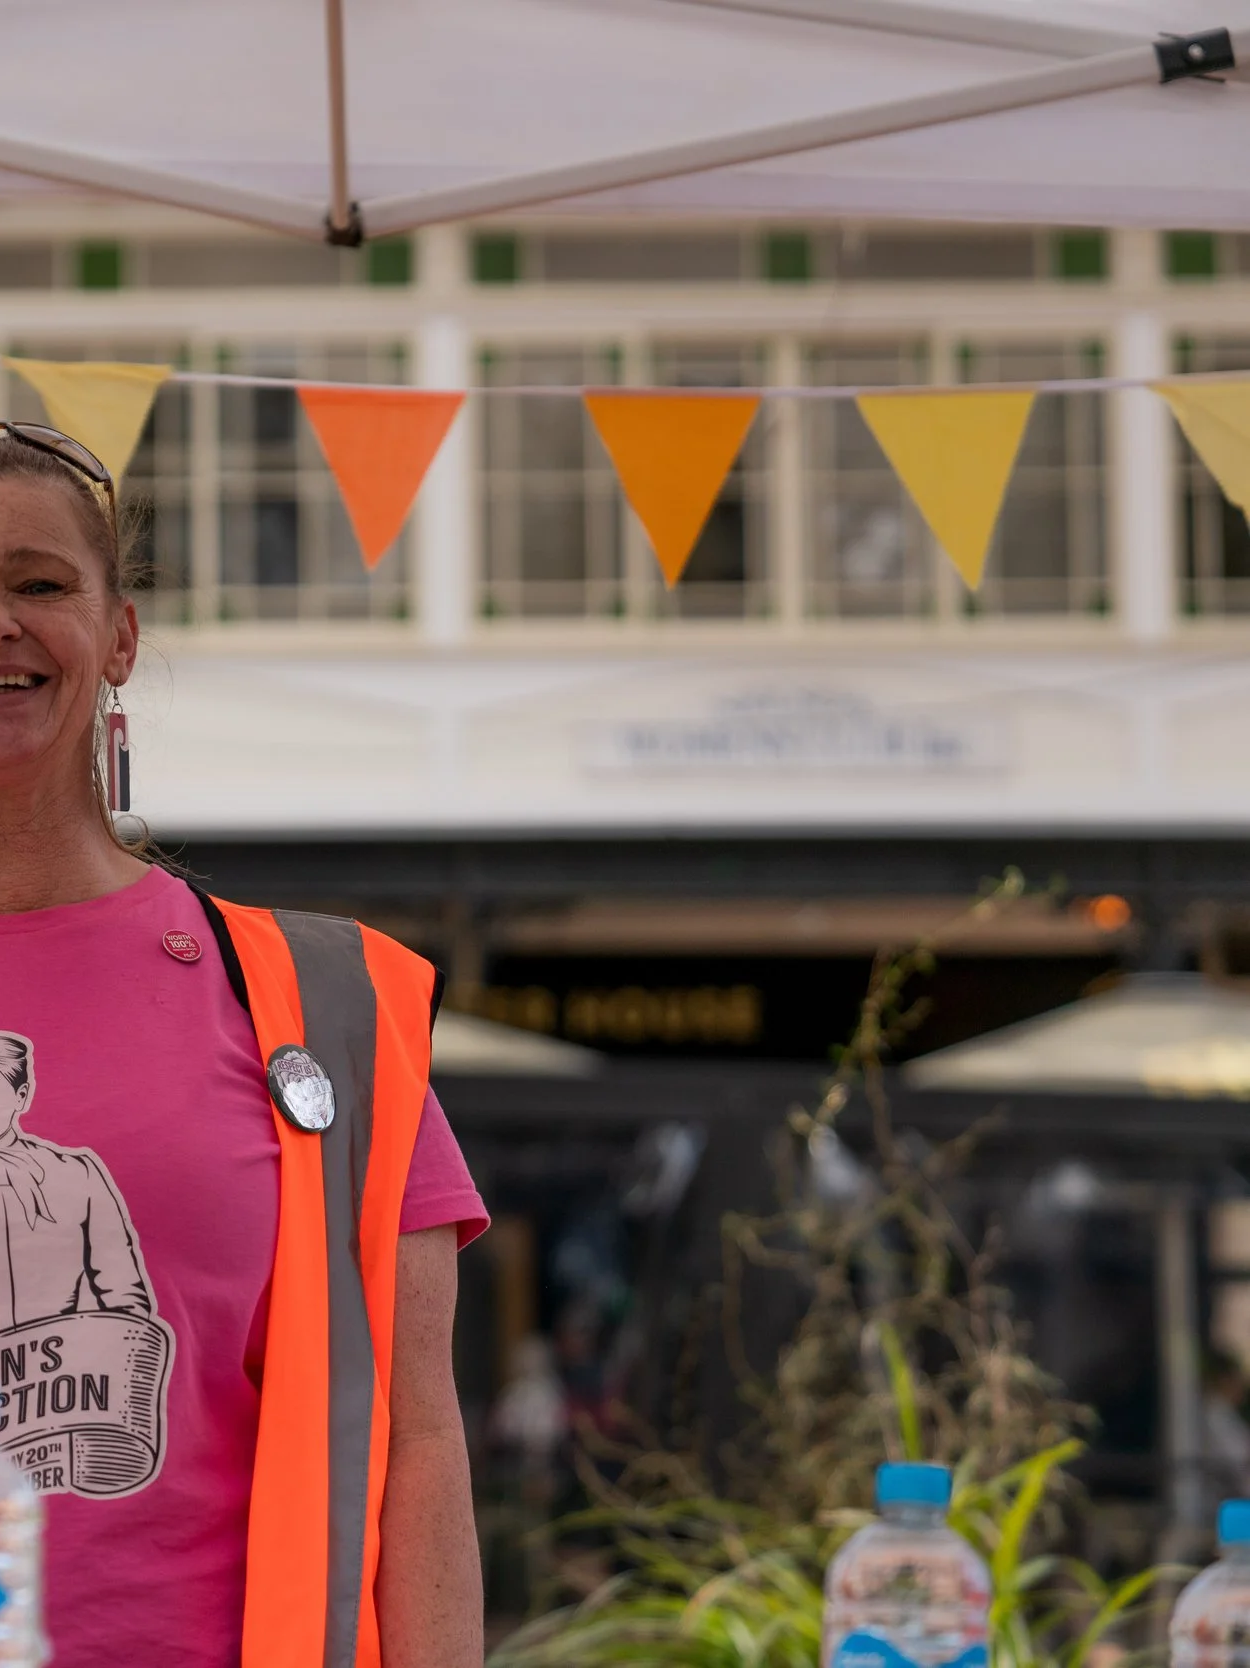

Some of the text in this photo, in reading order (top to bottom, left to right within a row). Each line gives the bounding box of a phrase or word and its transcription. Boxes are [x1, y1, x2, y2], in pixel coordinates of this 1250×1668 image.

[169, 940, 195, 948] 100%
[277, 1061, 303, 1073] RESPECT
[26, 1443, 62, 1465] 20TH
